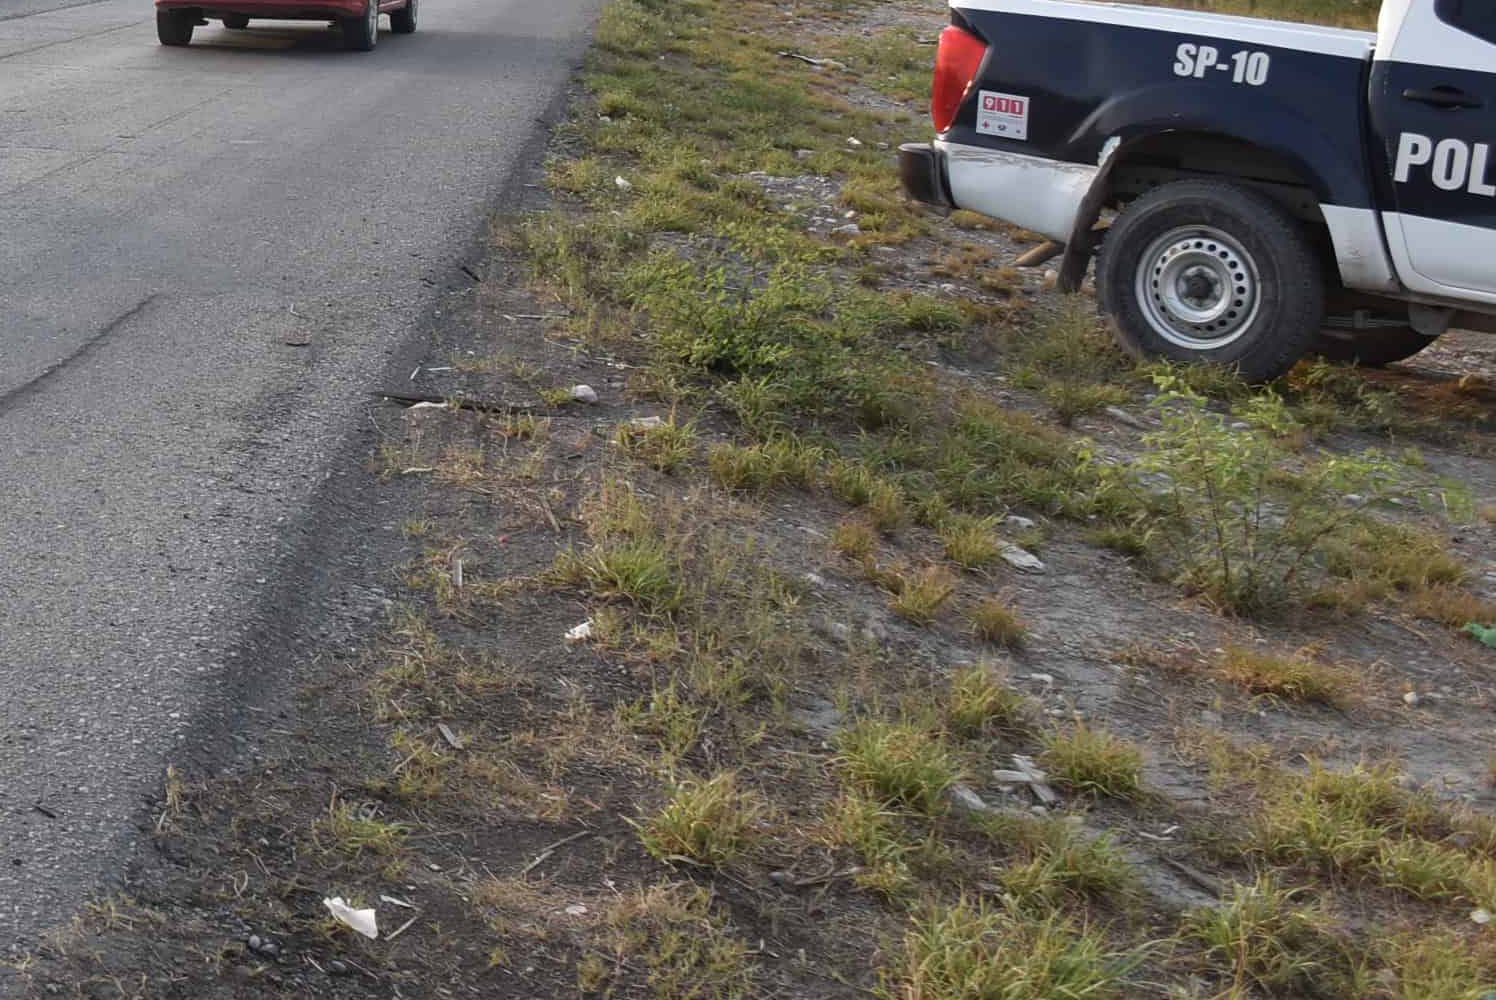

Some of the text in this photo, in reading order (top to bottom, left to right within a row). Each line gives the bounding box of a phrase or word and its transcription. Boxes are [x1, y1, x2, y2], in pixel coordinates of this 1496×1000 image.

[1173, 43, 1270, 86] SP-10
[984, 97, 1022, 114] 911
[1393, 132, 1496, 197] POL
